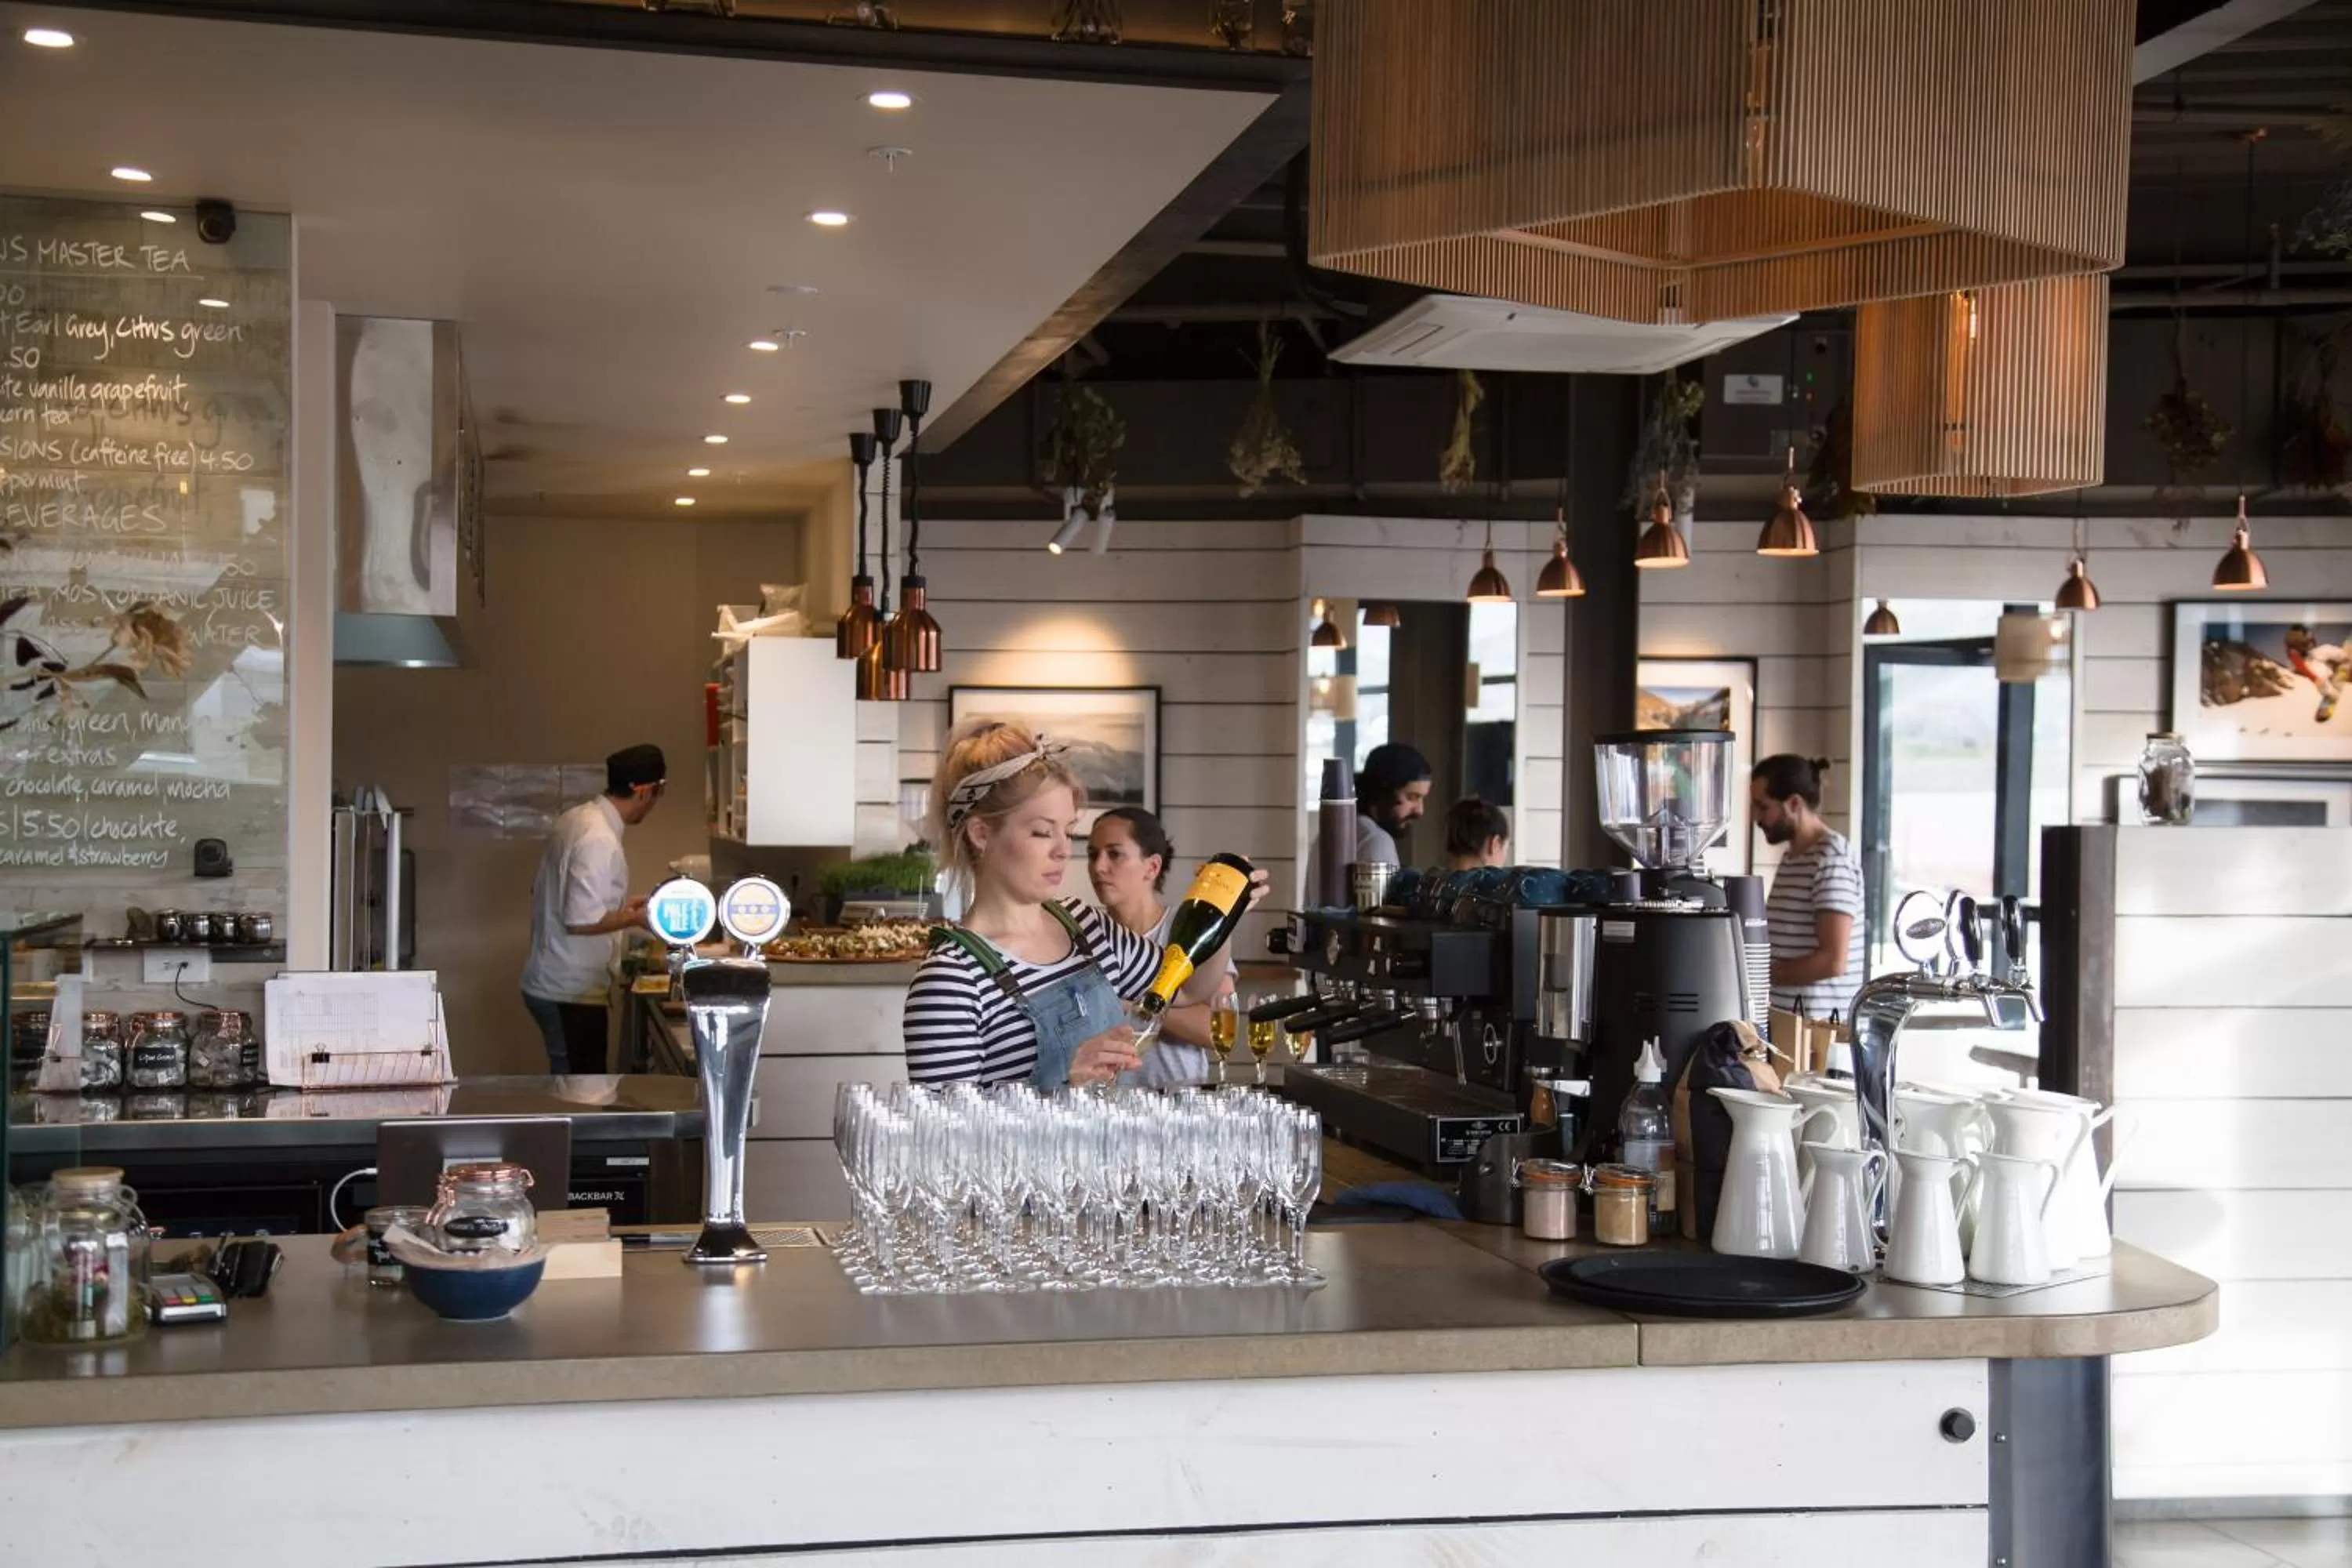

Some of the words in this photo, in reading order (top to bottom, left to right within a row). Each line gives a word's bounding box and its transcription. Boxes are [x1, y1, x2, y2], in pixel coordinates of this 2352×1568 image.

[37, 238, 136, 269] MASTER
[140, 245, 191, 273] TEA
[173, 325, 245, 358] green
[29, 374, 86, 400] vanilla
[201, 448, 254, 470] 4.50
[568, 1192, 613, 1200] BACKBAR
